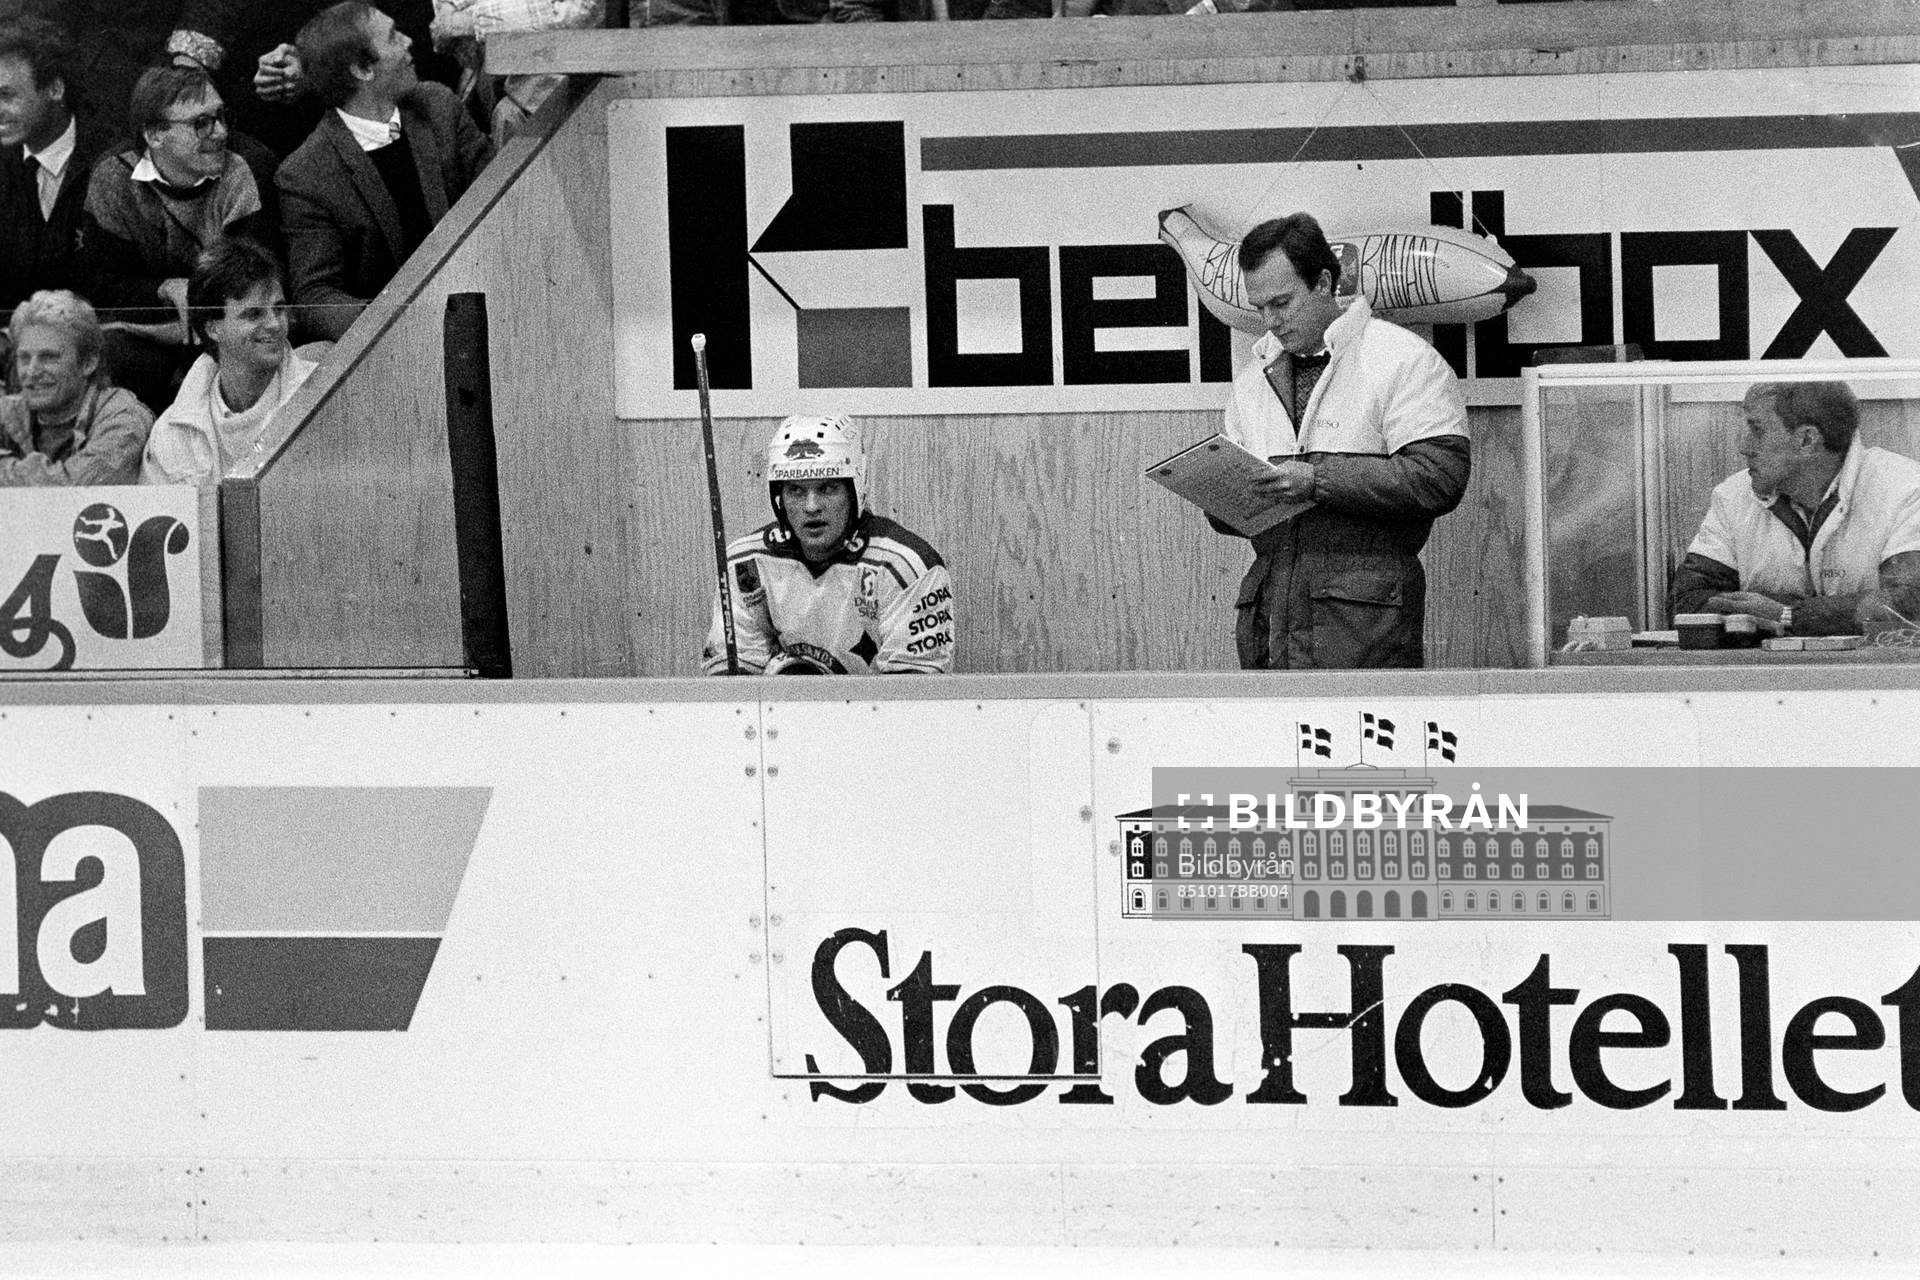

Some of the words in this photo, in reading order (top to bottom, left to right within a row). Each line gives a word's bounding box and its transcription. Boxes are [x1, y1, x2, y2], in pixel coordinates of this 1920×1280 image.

[774, 467, 840, 479] SPARBANKEN
[908, 607, 952, 636] STORA
[906, 631, 953, 655] STORA
[805, 926, 1234, 1106] Stora
